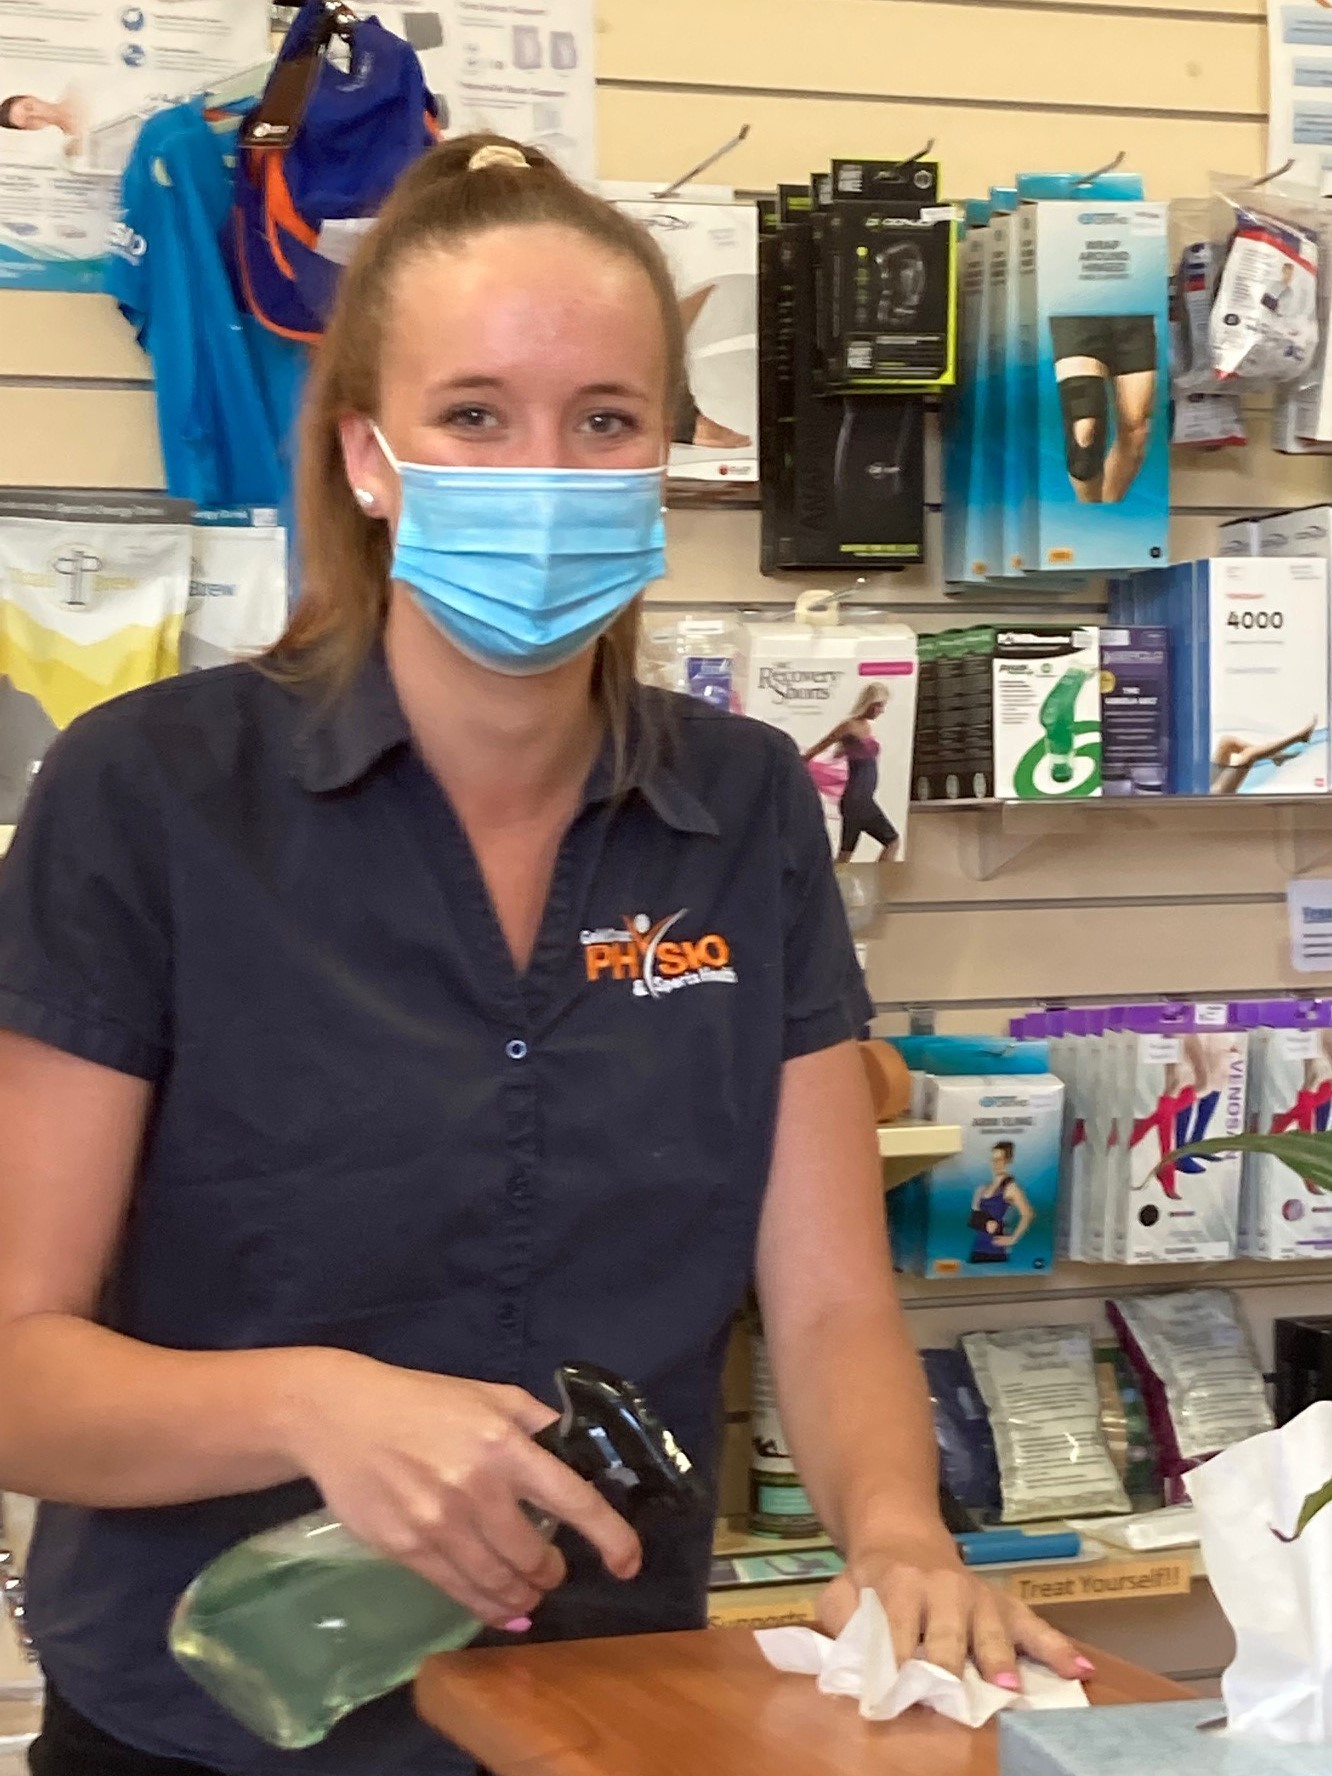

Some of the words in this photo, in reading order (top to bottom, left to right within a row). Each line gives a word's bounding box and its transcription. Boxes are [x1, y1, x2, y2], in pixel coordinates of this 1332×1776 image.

[1226, 611, 1284, 629] 4000
[757, 667, 844, 693] Recovery
[584, 912, 731, 985] PHYSIO
[1018, 1579, 1075, 1599] Treat
[1078, 1566, 1180, 1594] Yourself!!
